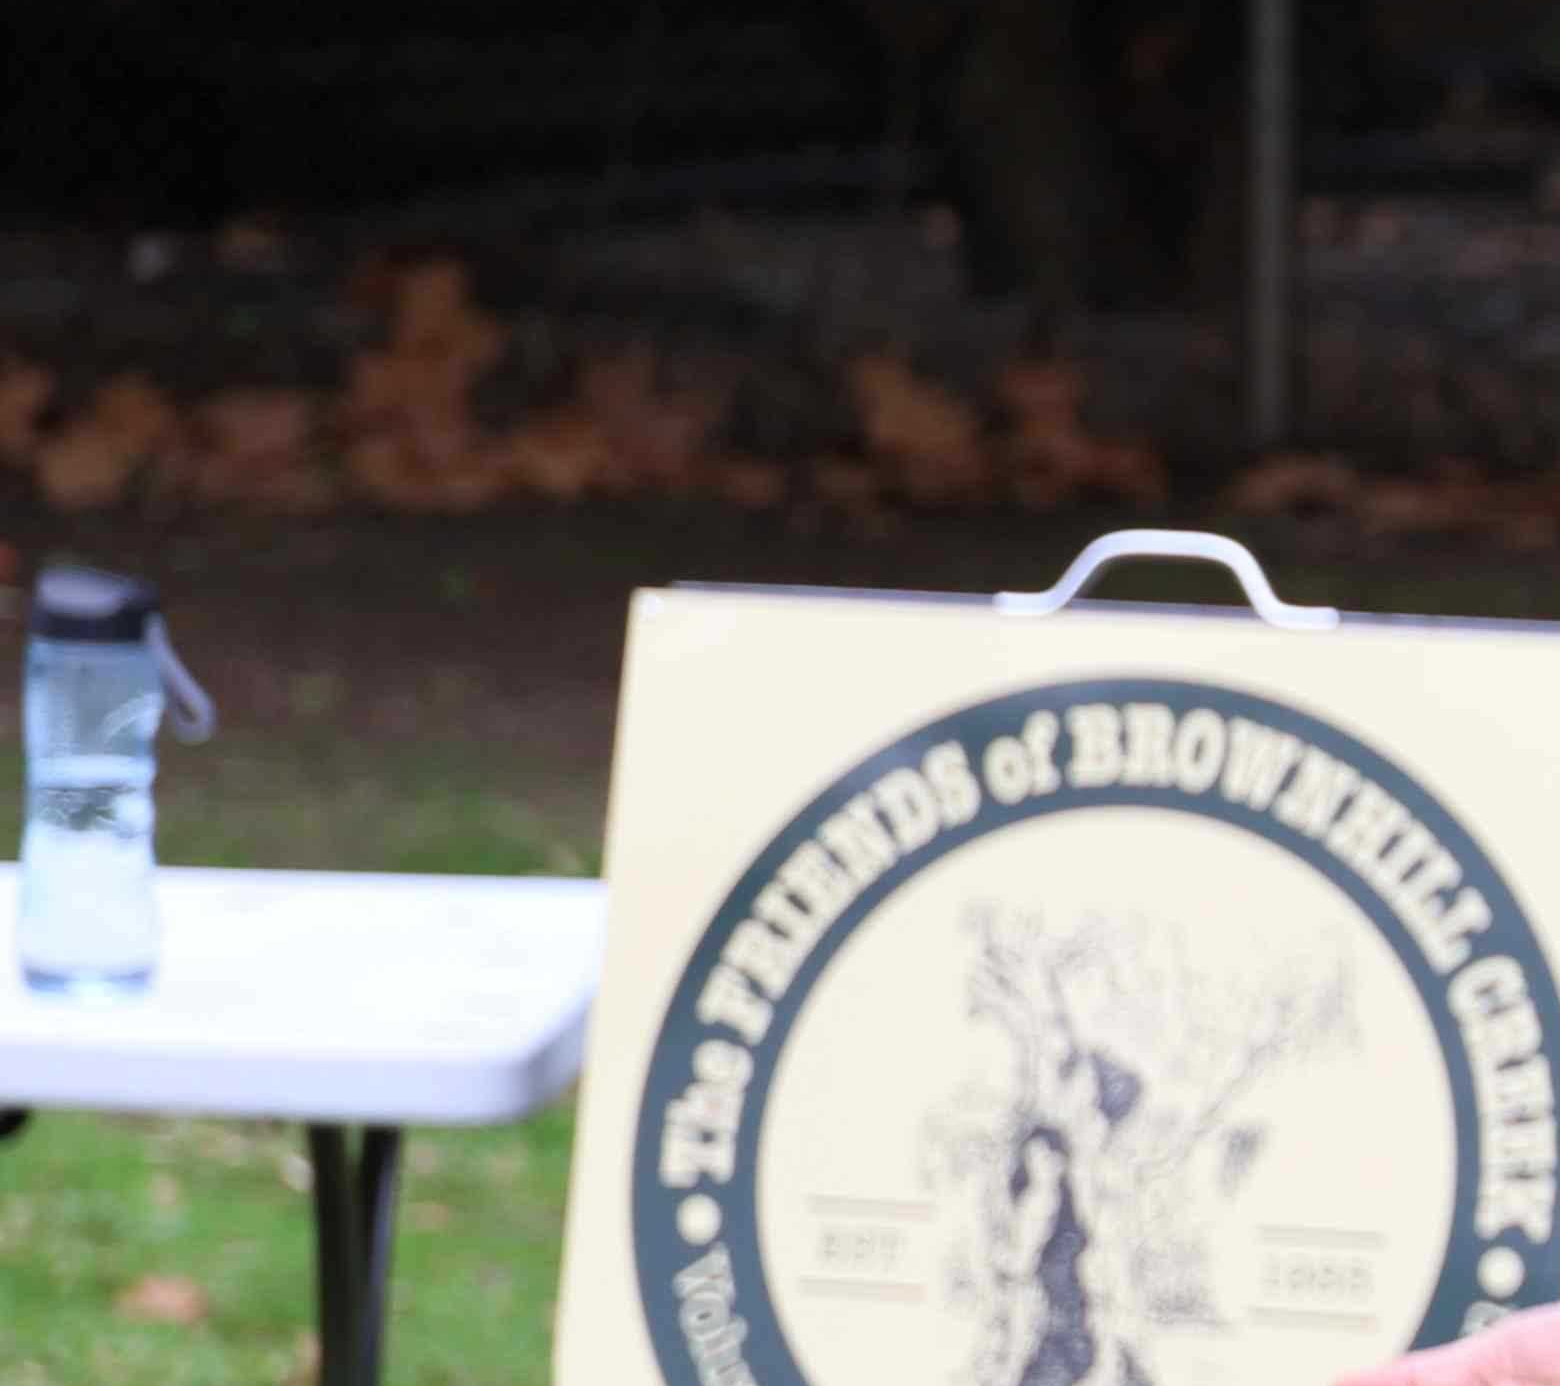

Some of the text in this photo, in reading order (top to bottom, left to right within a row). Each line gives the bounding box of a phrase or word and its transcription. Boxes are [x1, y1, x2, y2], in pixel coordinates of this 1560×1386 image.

[695, 738, 982, 1047] FRIENDS
[982, 708, 1062, 805] of
[1065, 701, 1492, 975] BROWNHILL
[1447, 953, 1558, 1245] CREEK
